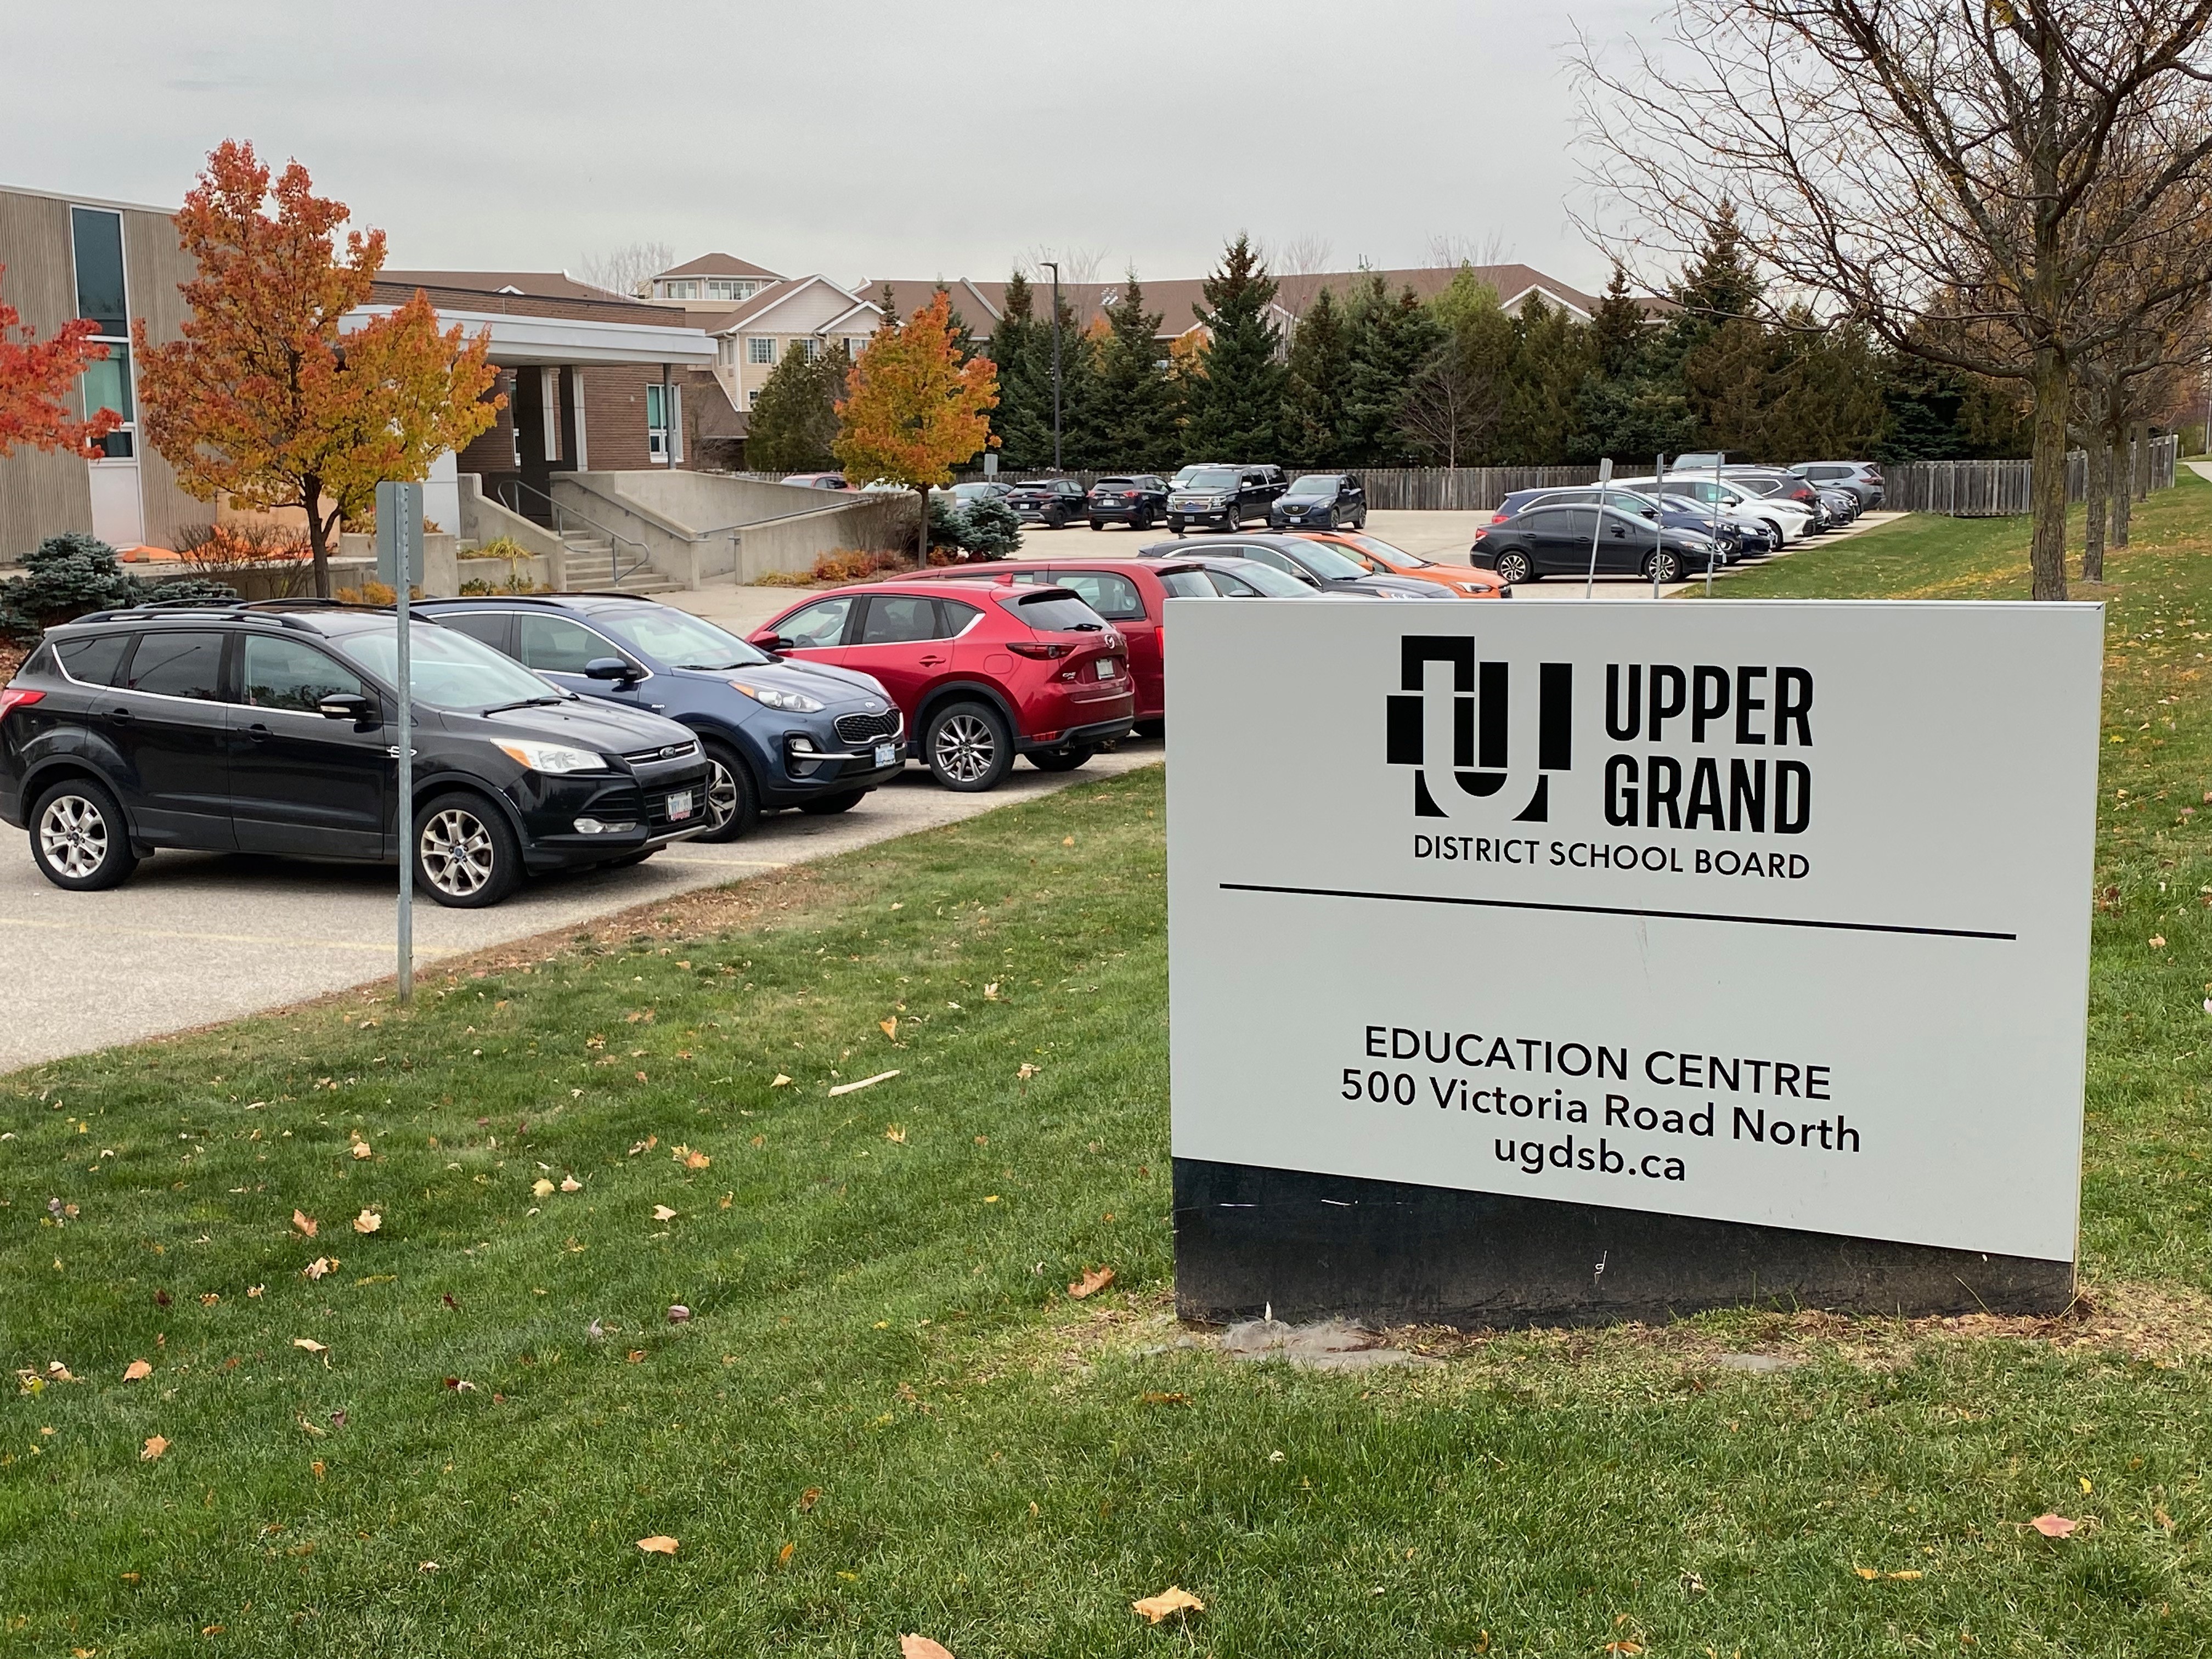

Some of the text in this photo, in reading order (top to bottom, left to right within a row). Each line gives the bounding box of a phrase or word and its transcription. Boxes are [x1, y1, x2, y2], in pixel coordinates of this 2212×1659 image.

[1605, 663, 1813, 747] UPPER
[1604, 754, 1811, 834] GRAND
[1414, 834, 1810, 879] DISTRICT SCHOOL BOARD
[1366, 1025, 1831, 1101] EDUCATION CENTRE
[1341, 1068, 1859, 1153] 500 Victoria Road North
[1495, 1134, 1685, 1181] ugdsb.ca
